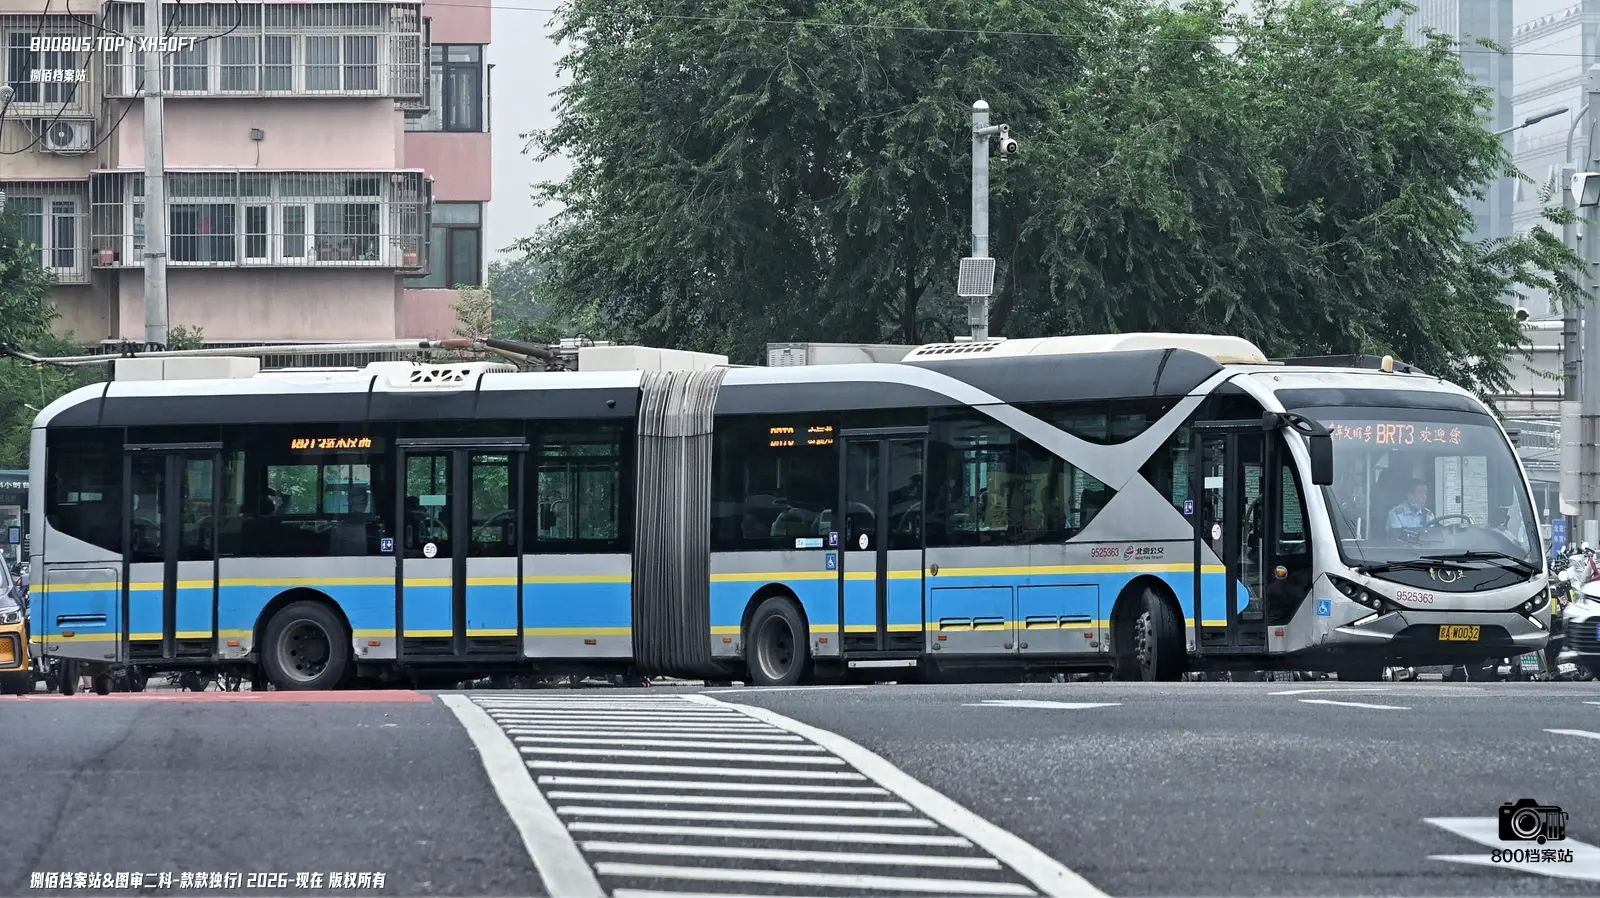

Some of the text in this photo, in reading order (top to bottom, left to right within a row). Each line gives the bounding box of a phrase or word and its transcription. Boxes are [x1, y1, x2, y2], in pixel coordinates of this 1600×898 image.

[1376, 423, 1415, 445] BRT3
[1420, 426, 1462, 445] 欢迎您
[1091, 547, 1119, 558] 9525363
[1136, 547, 1164, 555] 北京公交
[1396, 591, 1434, 604] 9525363
